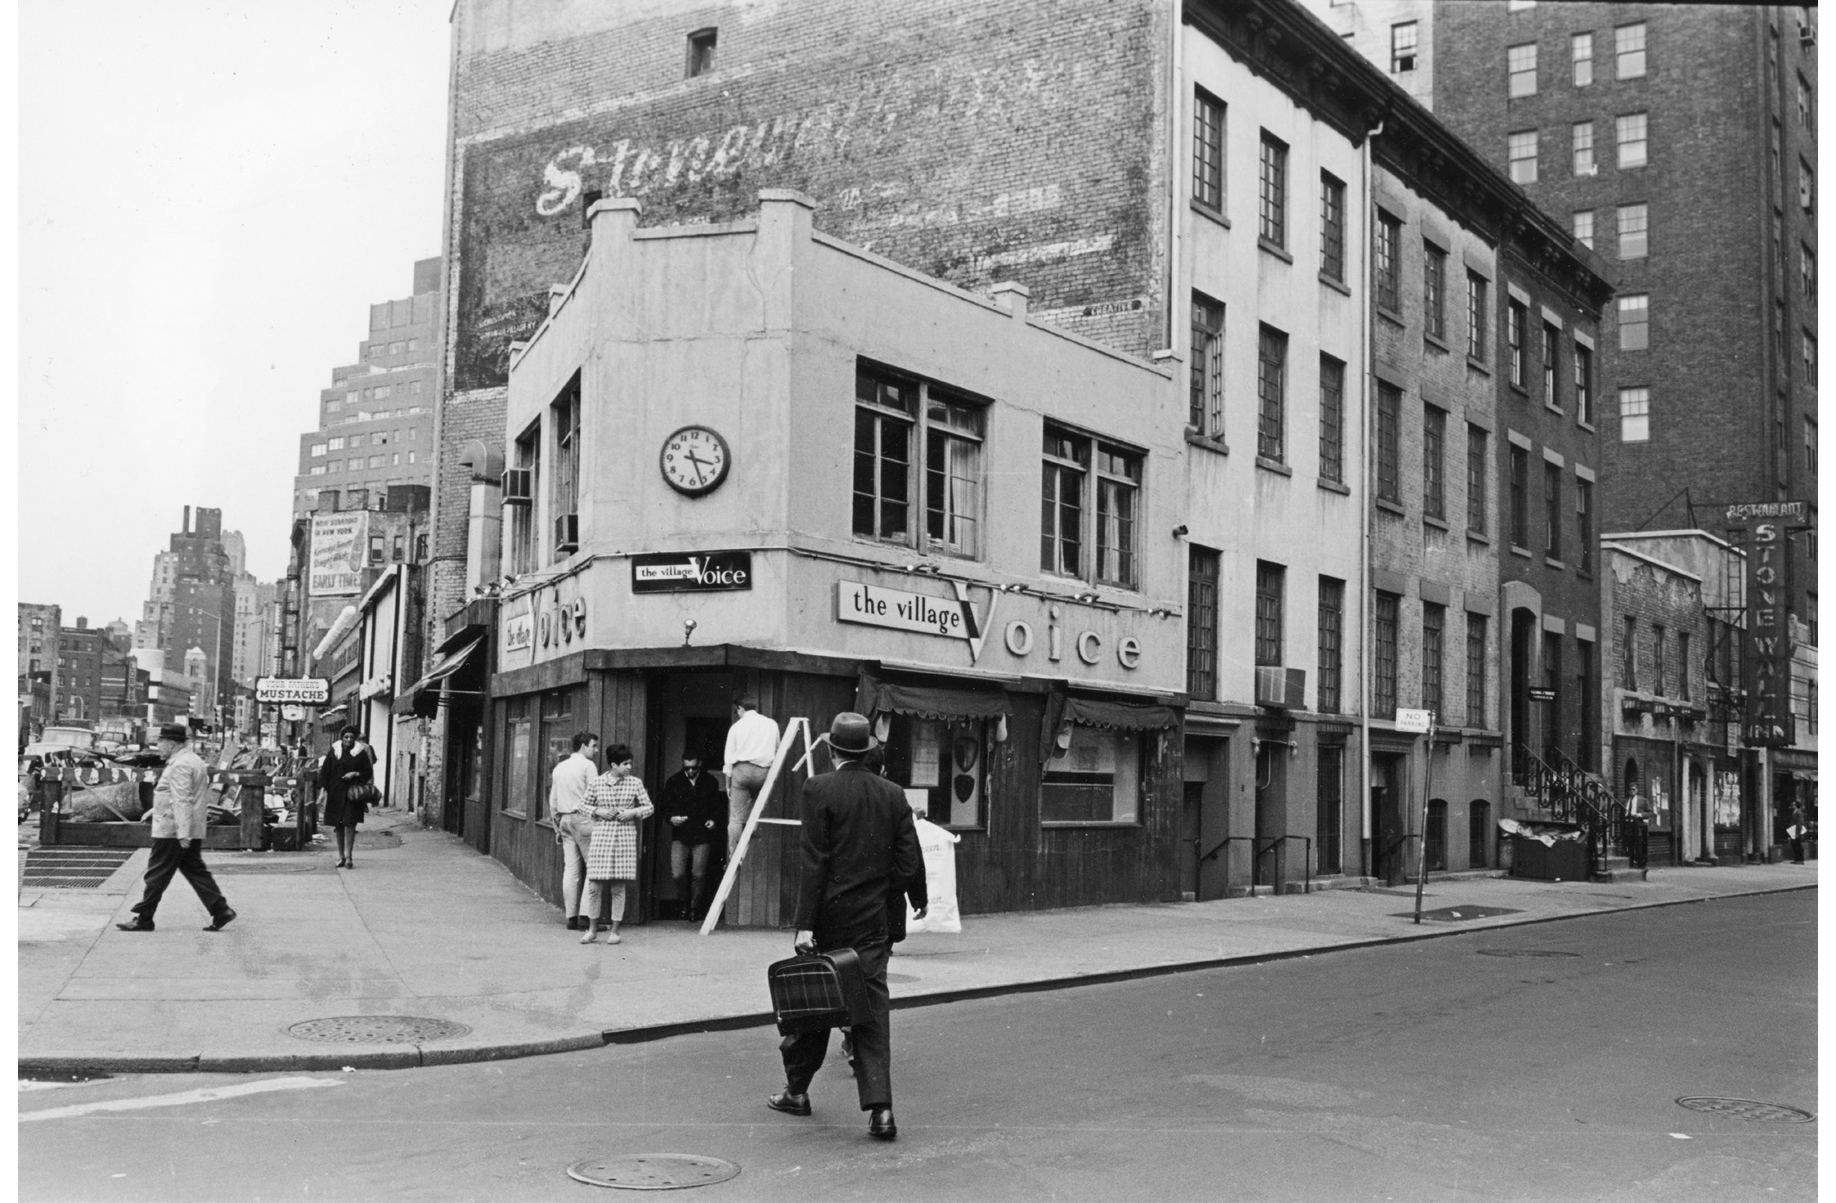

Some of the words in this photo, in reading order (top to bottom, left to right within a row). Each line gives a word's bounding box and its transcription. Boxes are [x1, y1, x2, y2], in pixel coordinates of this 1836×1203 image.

[691, 431, 699, 440] 12
[706, 435, 709, 443] 1
[713, 443, 718, 451] 2
[667, 454, 673, 462] 9
[715, 455, 720, 463] 3
[670, 465, 676, 474] 8
[709, 468, 715, 476] 4
[679, 475, 684, 483] 7
[690, 477, 696, 486] 6
[702, 475, 707, 484] 5
[641, 568, 657, 577] the
[661, 566, 693, 579] village
[688, 556, 746, 585] Voice
[313, 574, 335, 588] EARLY
[339, 573, 361, 588] TIMES
[530, 587, 587, 665] Voice
[854, 585, 887, 616] the
[897, 596, 960, 634] village
[950, 580, 1142, 670] Voice
[260, 690, 324, 700] MUSTACHE
[1406, 713, 1421, 721] NO
